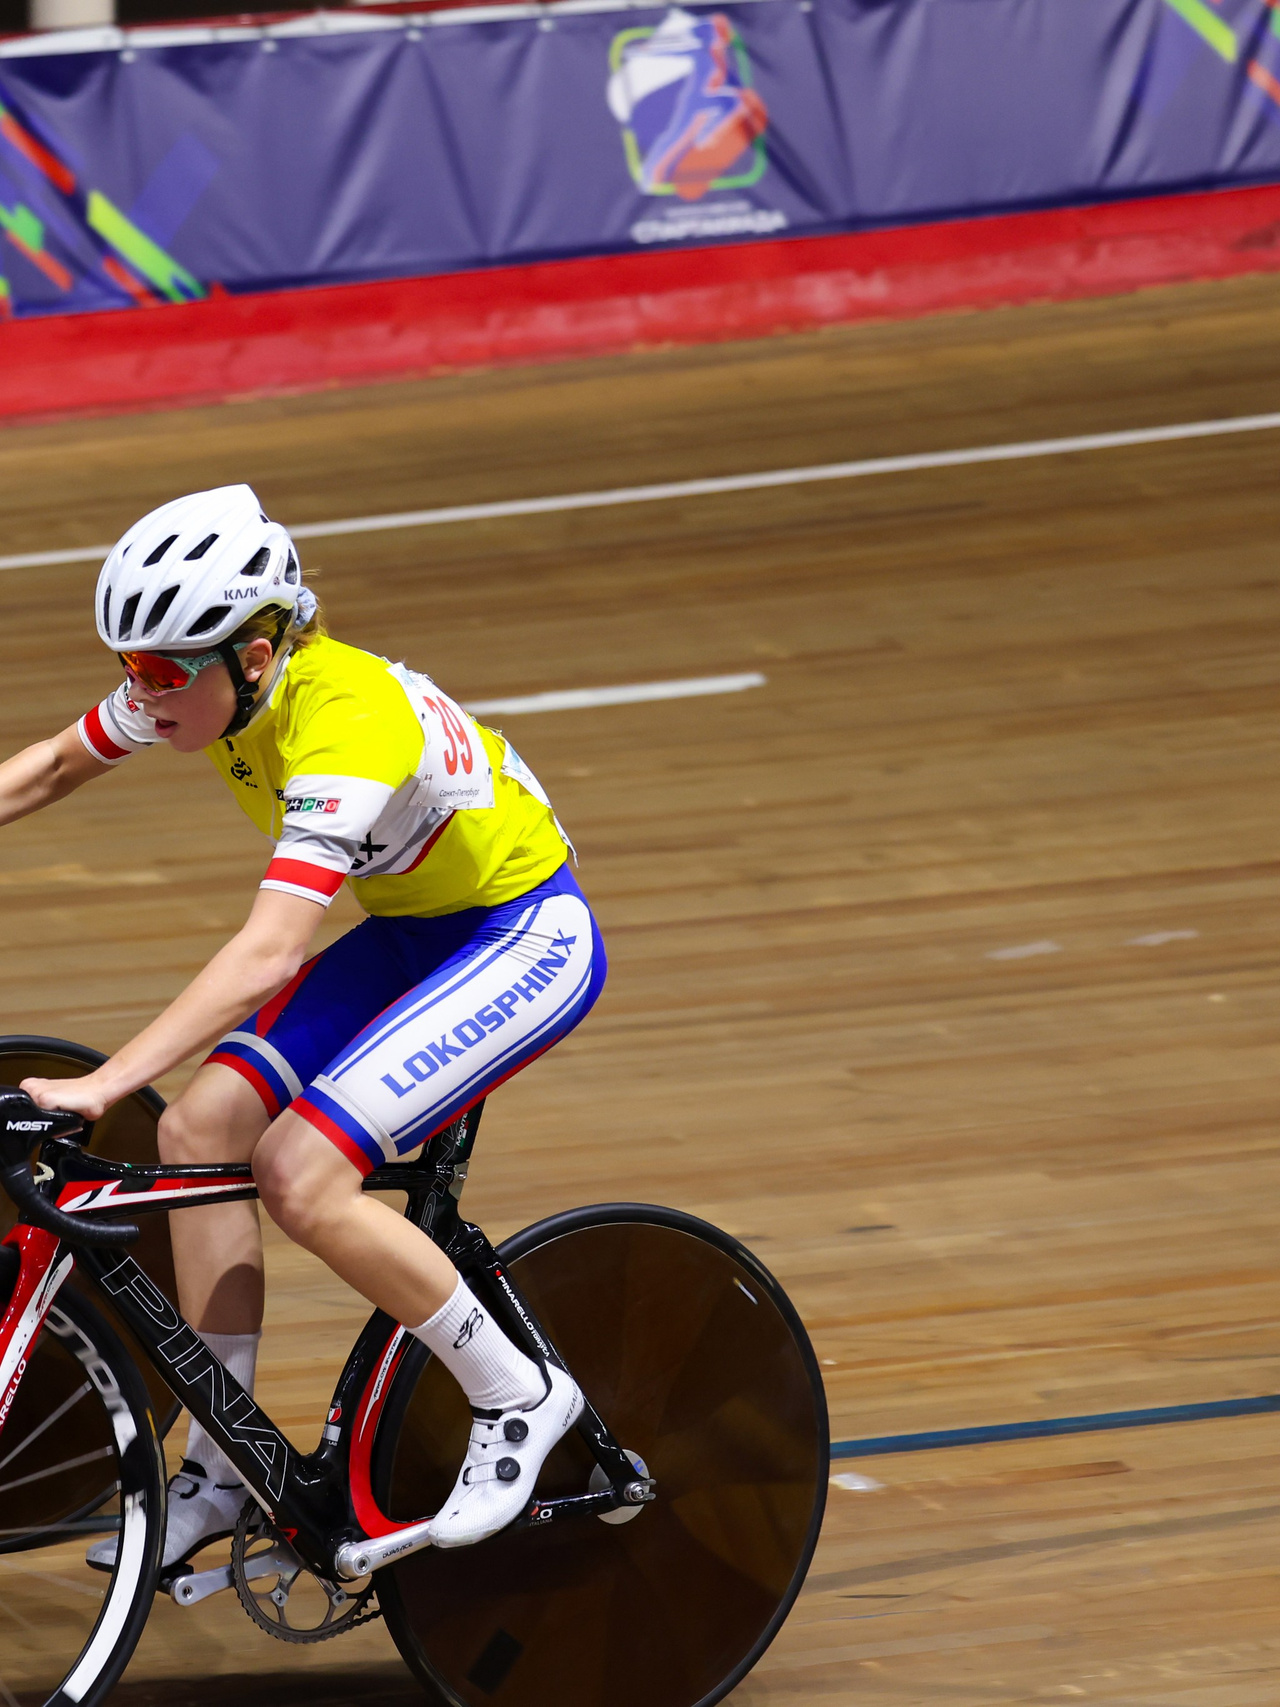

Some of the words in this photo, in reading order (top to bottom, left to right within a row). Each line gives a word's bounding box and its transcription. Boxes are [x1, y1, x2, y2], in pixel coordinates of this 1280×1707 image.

[224, 586, 258, 600] KASK
[422, 696, 473, 776] 39
[380, 928, 577, 1099] LOKOSPHINX
[456, 1112, 469, 1146] MONTE
[498, 1275, 534, 1330] PINARELLO
[100, 1256, 293, 1502] PINA
